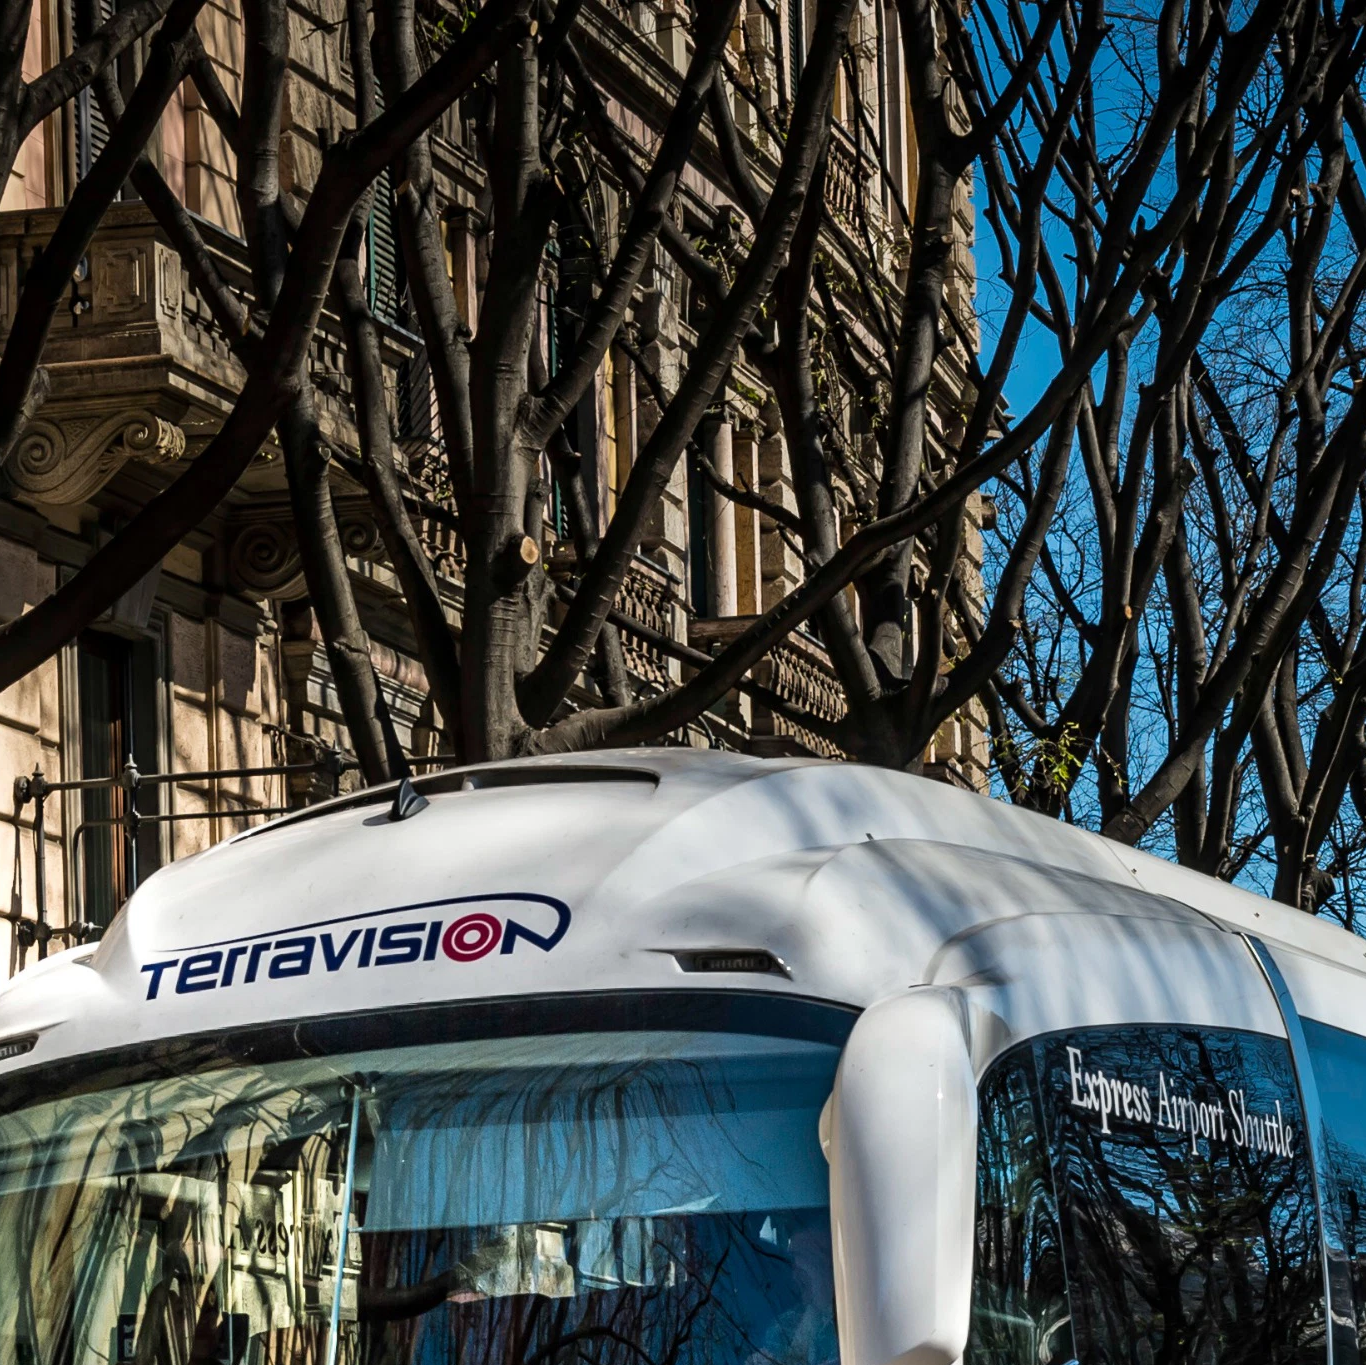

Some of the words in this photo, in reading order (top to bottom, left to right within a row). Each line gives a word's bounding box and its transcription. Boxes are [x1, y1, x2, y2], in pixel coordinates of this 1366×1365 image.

[1066, 1045, 1151, 1135] Express
[1157, 1071, 1227, 1155] Airport
[1228, 1088, 1295, 1159] Shuttle
